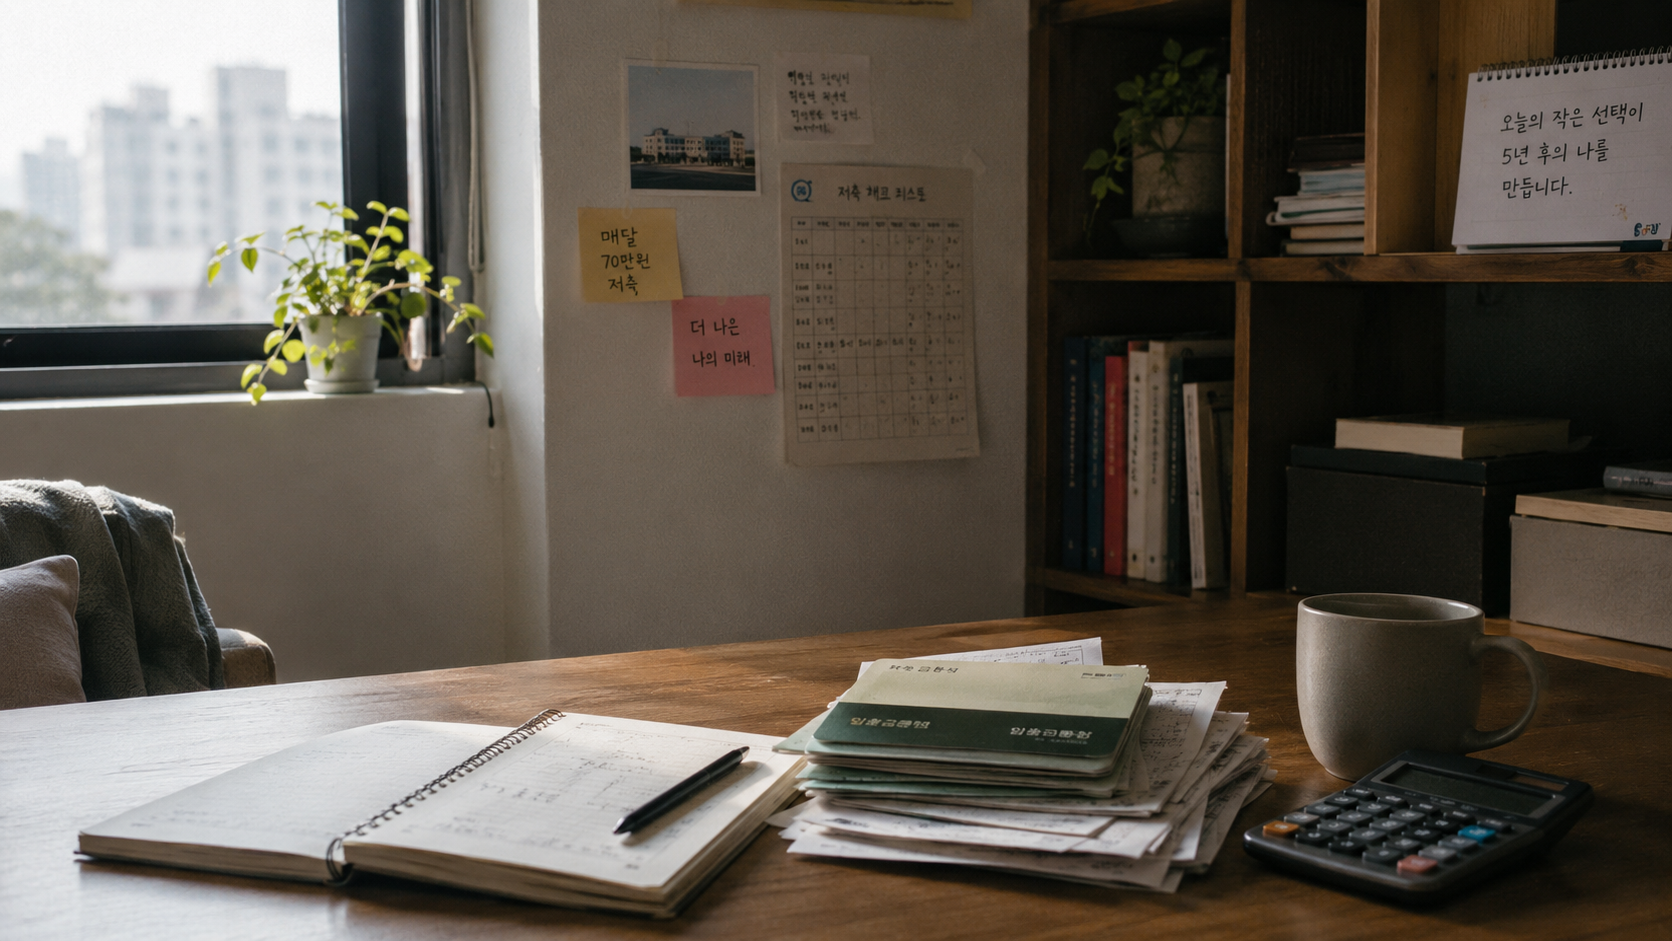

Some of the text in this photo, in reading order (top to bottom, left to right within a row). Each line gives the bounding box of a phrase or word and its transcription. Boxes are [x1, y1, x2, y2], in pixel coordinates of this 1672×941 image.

[1500, 101, 1644, 134] 오늘의 작은 선택이
[1501, 138, 1609, 166] 5년 후의 나를
[1502, 176, 1573, 200] 만듭니다.
[600, 226, 638, 248] 매달
[600, 252, 651, 271] 70만원
[690, 317, 740, 337] 더 나은
[692, 350, 751, 368] 나의 미래
